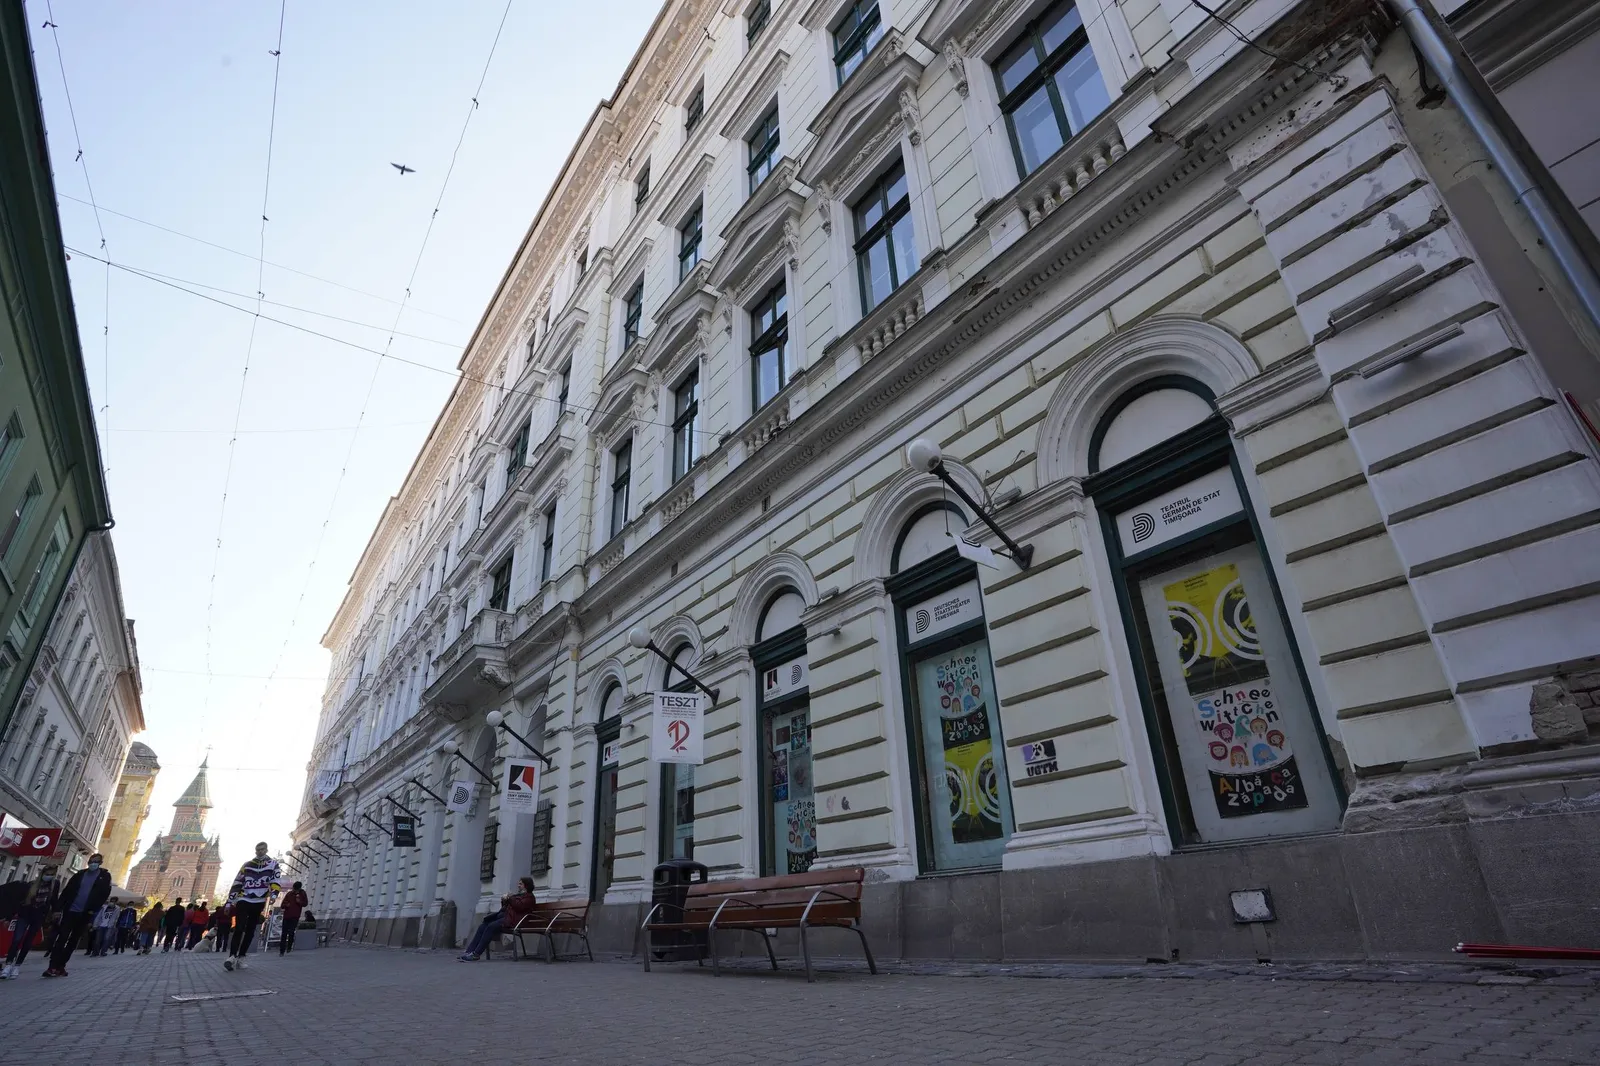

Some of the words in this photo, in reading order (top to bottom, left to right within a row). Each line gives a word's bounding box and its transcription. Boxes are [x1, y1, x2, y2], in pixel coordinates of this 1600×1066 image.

[1160, 497, 1191, 513] TEATRUL
[1162, 503, 1191, 520] GERMAN
[1193, 499, 1202, 507] DE
[1204, 490, 1221, 502] STAT
[933, 597, 960, 612] DEUTSCHES
[934, 598, 971, 616] STAATSTHEATER
[935, 608, 960, 621] TEMESWAR
[659, 695, 699, 707] TESZT
[1198, 689, 1271, 718] Schnee
[1200, 700, 1279, 732] wittchen
[1026, 760, 1059, 777] UGTM
